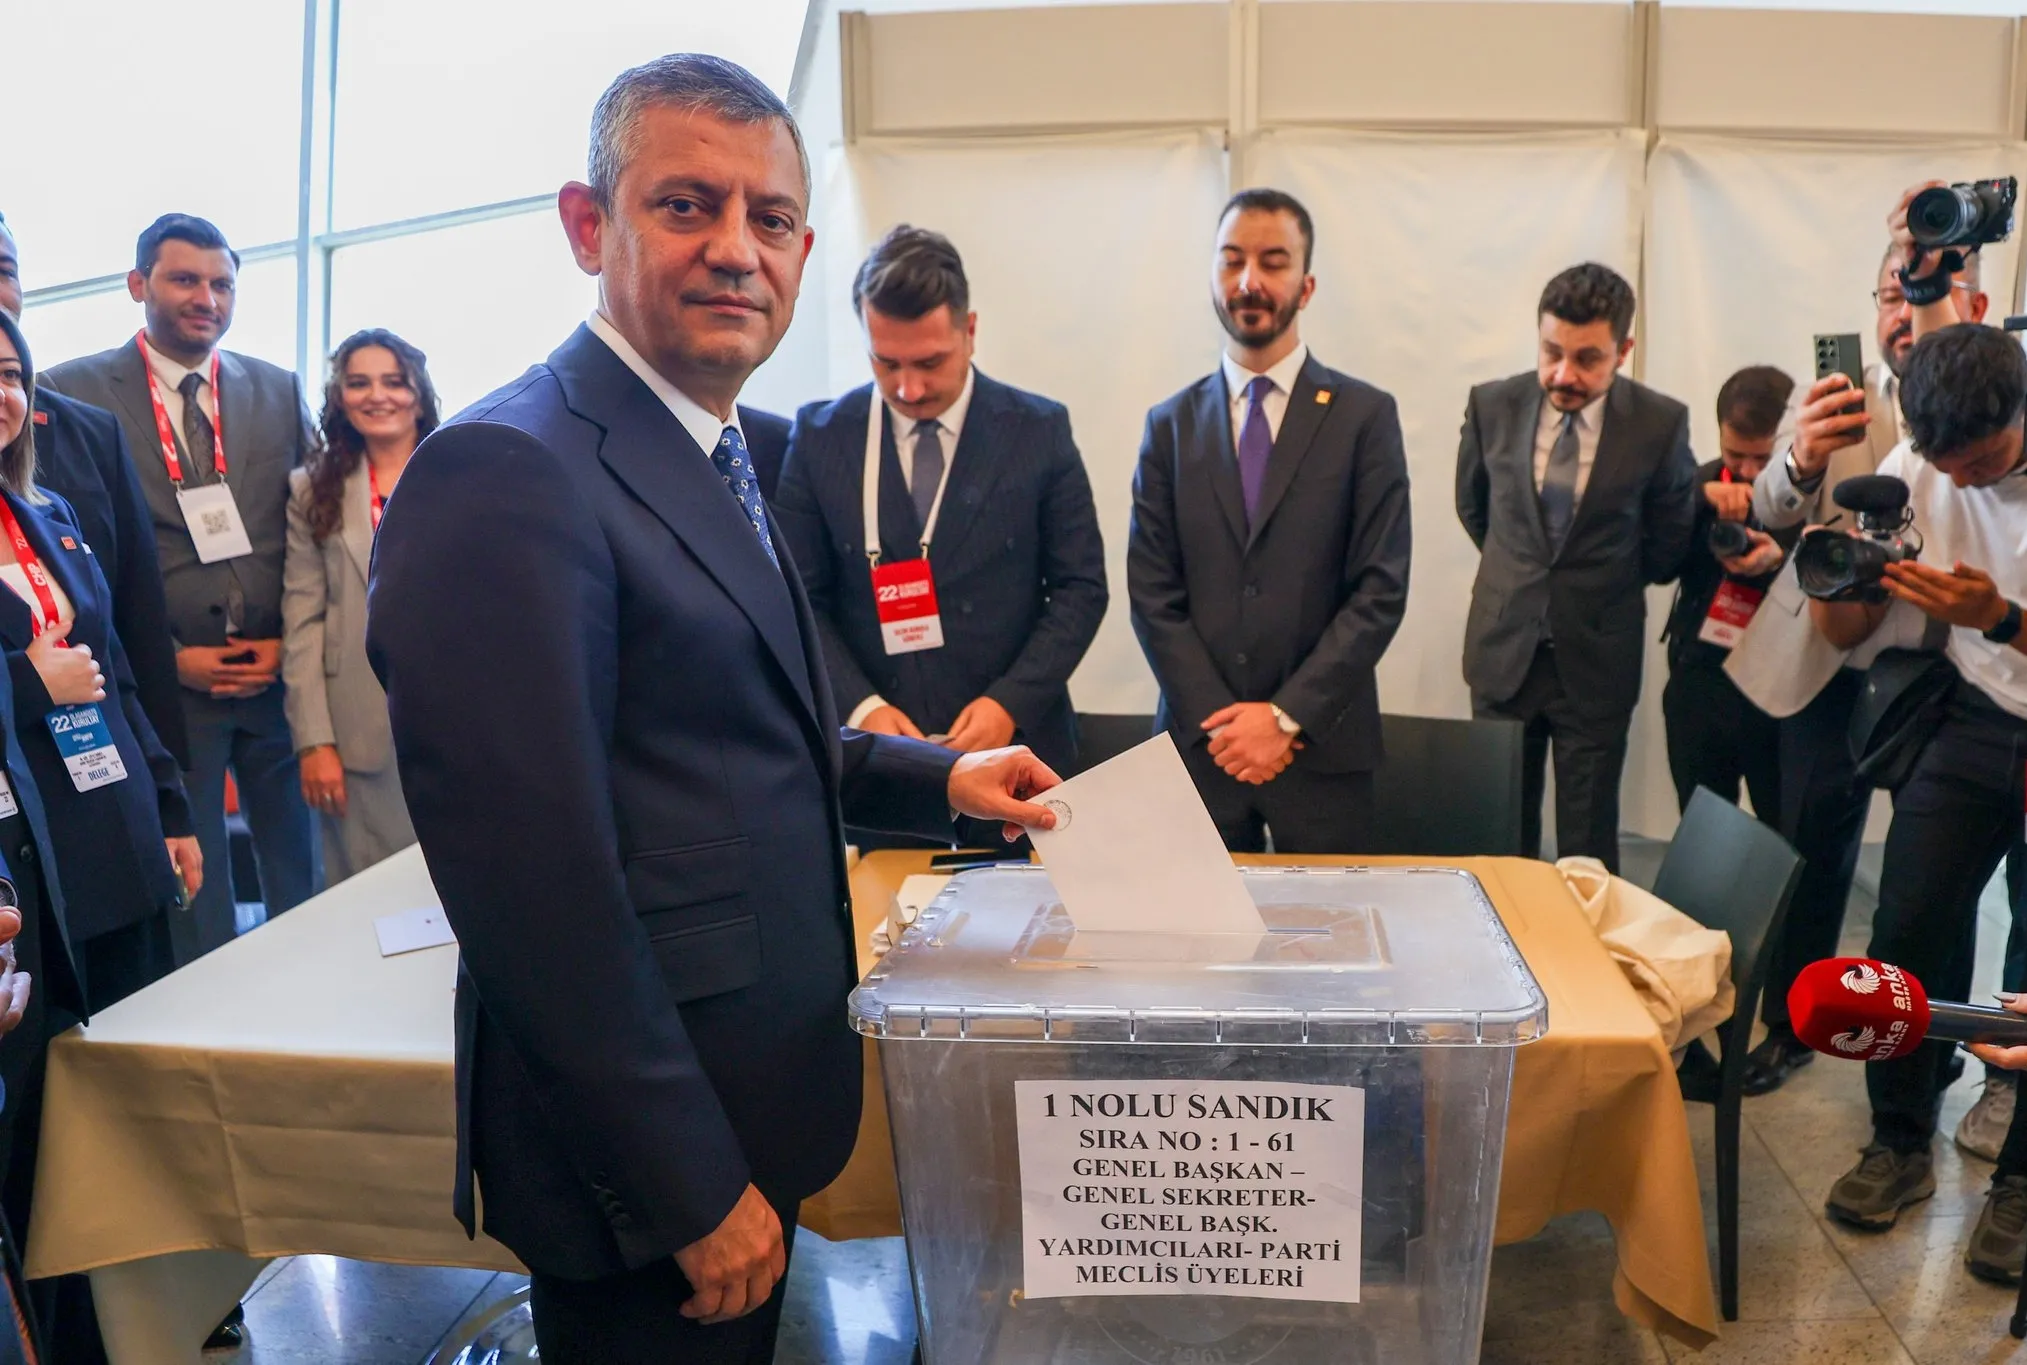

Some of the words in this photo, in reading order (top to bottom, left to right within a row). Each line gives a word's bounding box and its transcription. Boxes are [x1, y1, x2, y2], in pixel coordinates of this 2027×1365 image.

[877, 584, 899, 603] 22
[51, 715, 74, 734] 22
[87, 767, 111, 782] DELEGE
[1880, 962, 1906, 1011] anka
[1043, 1092, 1058, 1118] 1
[1070, 1093, 1177, 1119] NOLU
[1187, 1094, 1335, 1123] SANDIK
[1079, 1129, 1149, 1151] SIRA
[1158, 1130, 1202, 1152] NO
[1229, 1131, 1240, 1152] 1
[1267, 1131, 1296, 1152] 61
[1072, 1158, 1166, 1179] GENEL
[1173, 1160, 1284, 1184] BAŞKAN
[1062, 1184, 1155, 1205] GENEL
[1161, 1187, 1317, 1208] SEKRETER-
[1100, 1211, 1193, 1233] GENEL
[1200, 1214, 1279, 1238] BAŞK.
[1038, 1237, 1254, 1260] YARDIMCILARI-
[1260, 1239, 1341, 1262] PARTİ
[1075, 1261, 1180, 1285] MECLİS
[1186, 1262, 1305, 1289] ÜYELERİ
